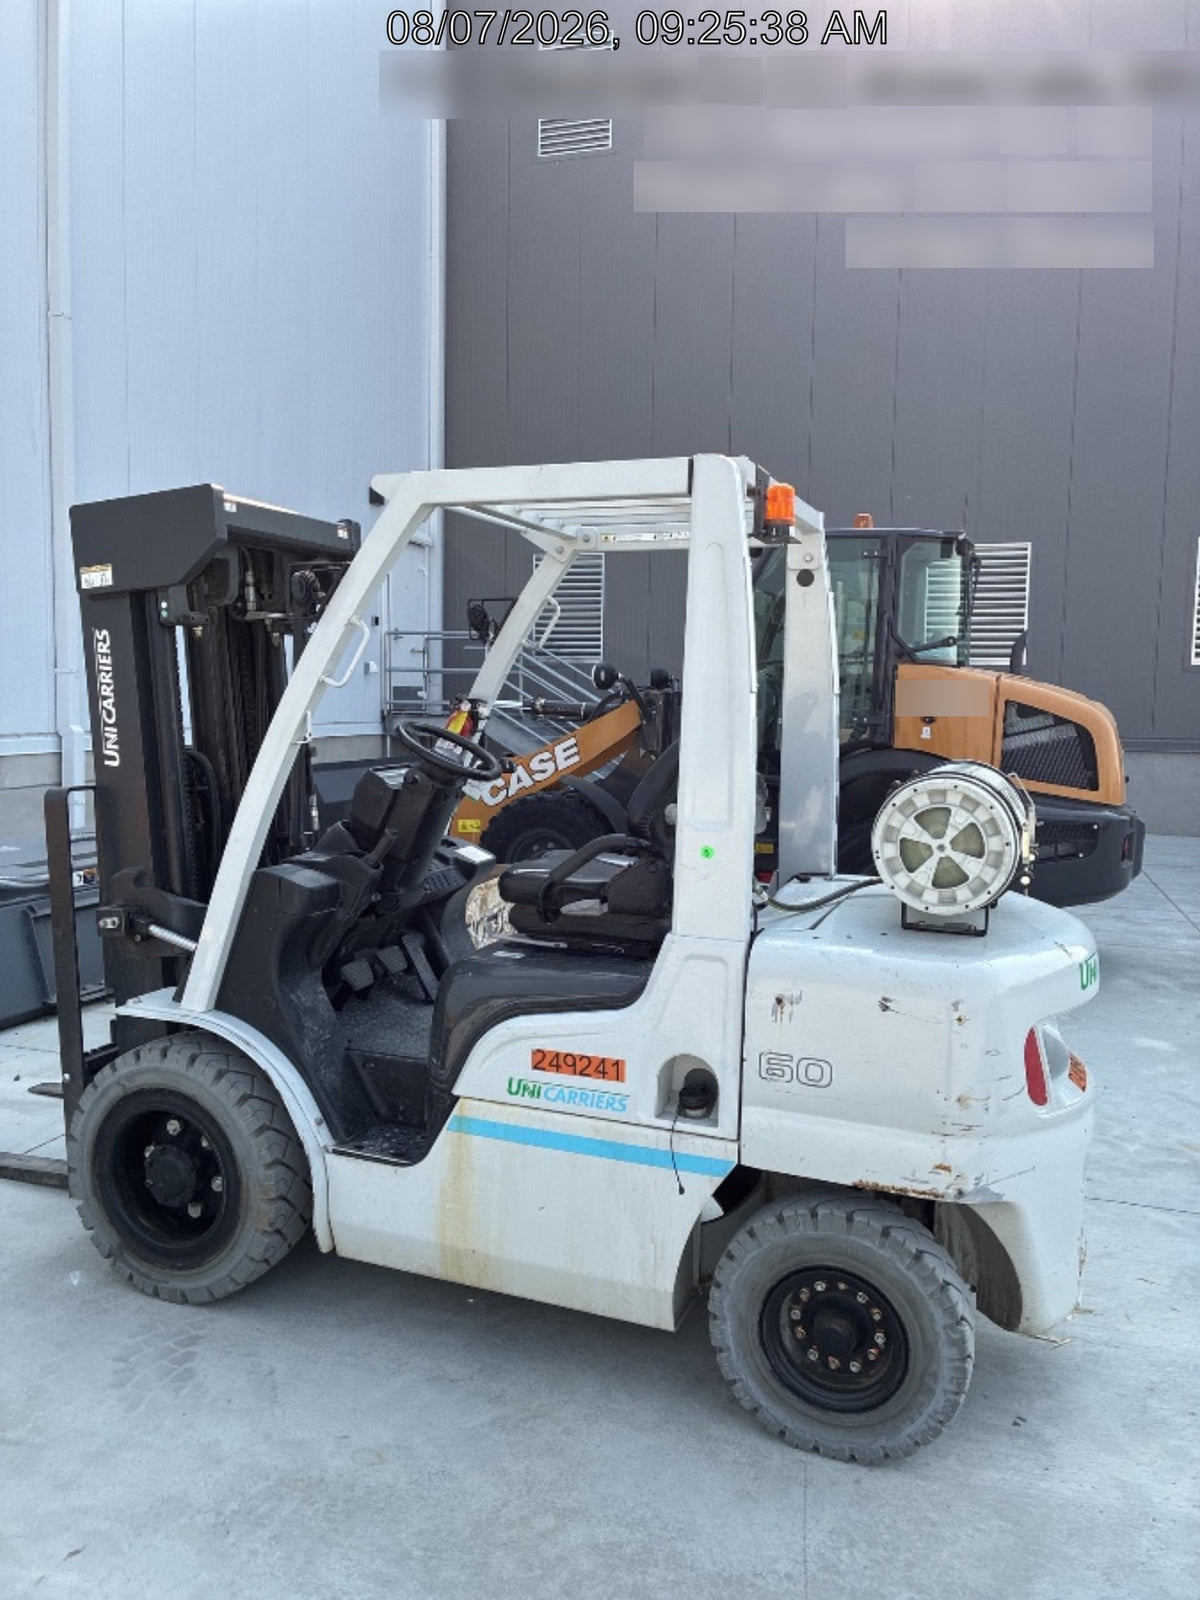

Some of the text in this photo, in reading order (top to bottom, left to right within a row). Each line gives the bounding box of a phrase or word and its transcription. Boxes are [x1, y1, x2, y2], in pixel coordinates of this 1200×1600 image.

[480, 737, 581, 806] CASE
[531, 1049, 624, 1082] 249241
[758, 1050, 833, 1089] 60
